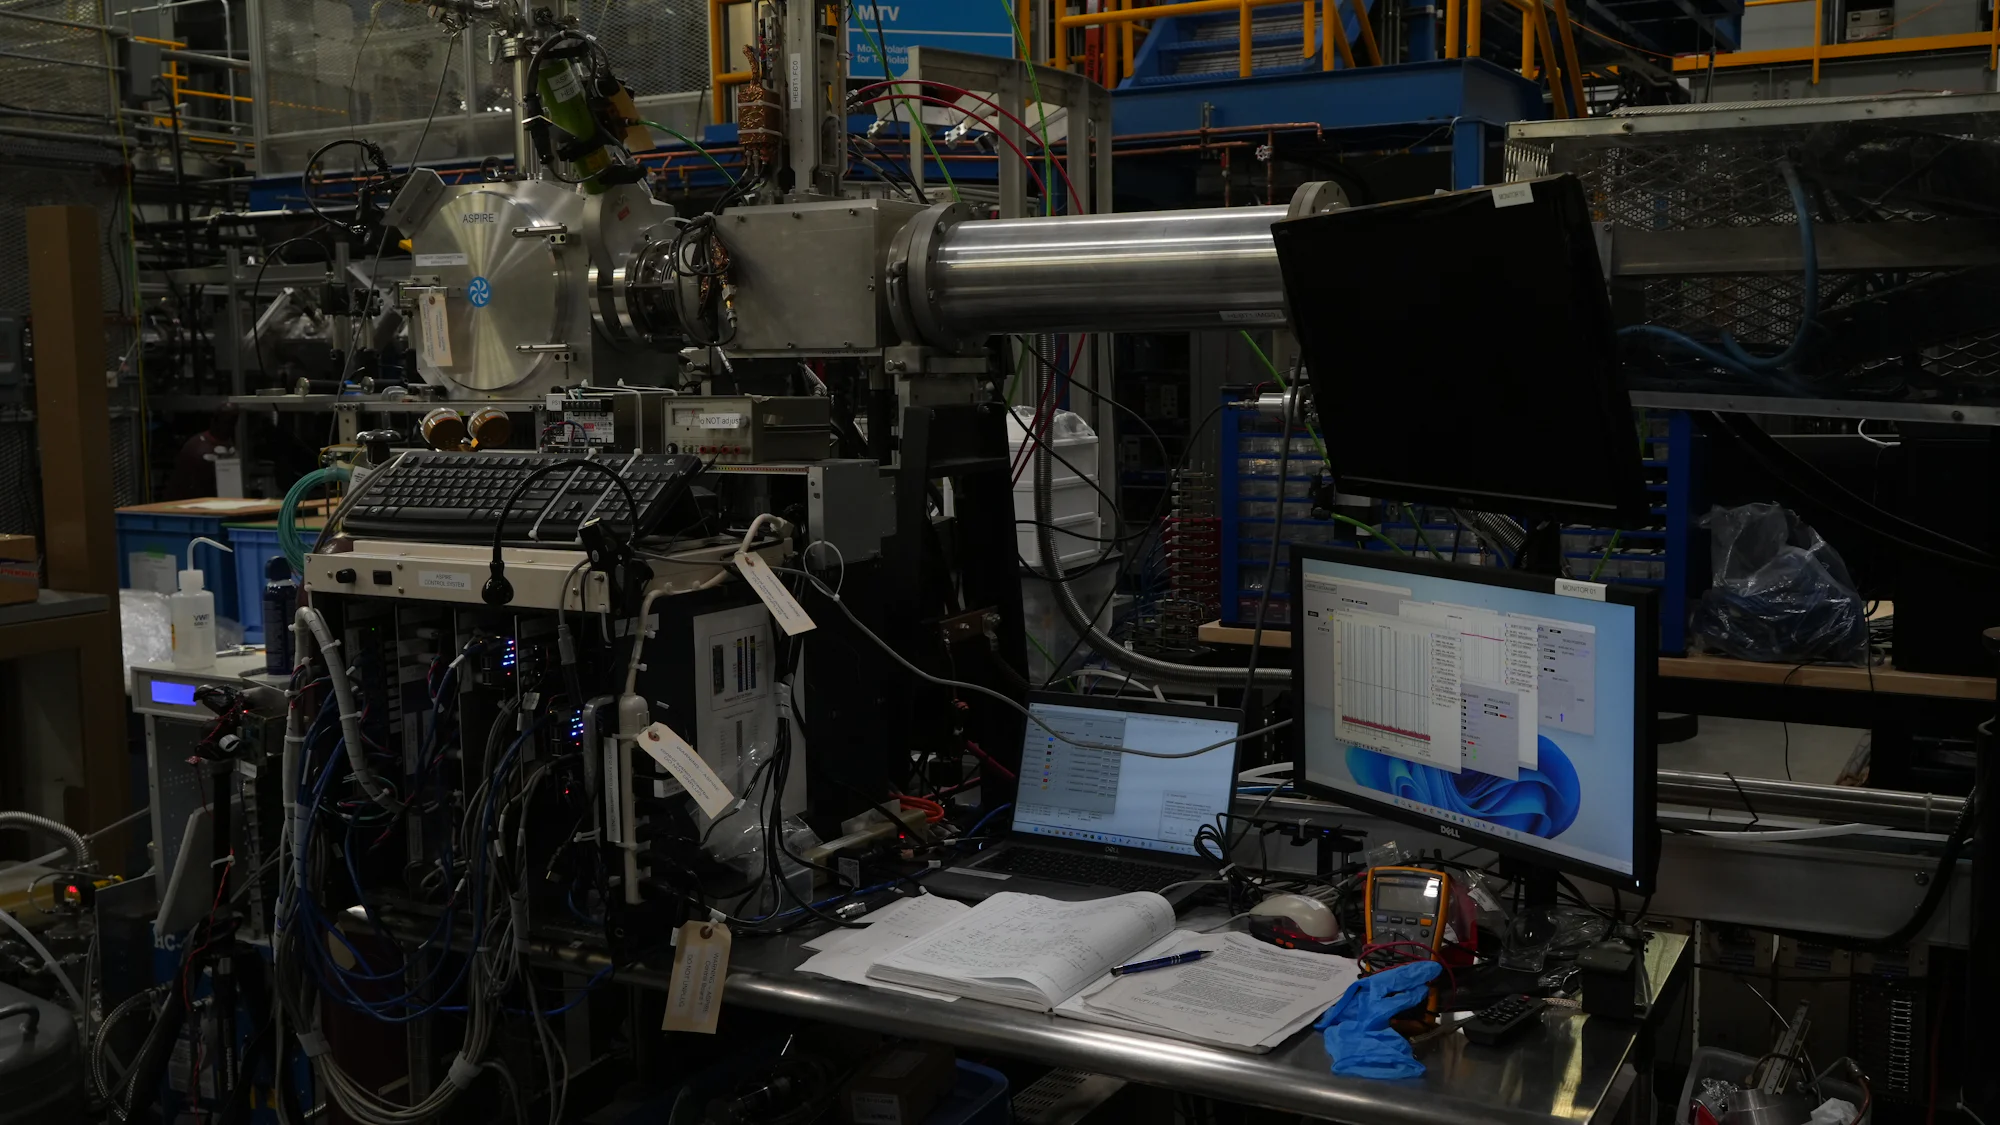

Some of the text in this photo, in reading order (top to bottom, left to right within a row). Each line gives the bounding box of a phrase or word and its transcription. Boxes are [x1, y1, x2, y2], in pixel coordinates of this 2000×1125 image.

[858, 4, 900, 22] MTV
[857, 55, 870, 63] for
[462, 214, 494, 223] ASPIRE
[1562, 584, 1589, 594] MONITOR
[675, 762, 691, 779] system
[676, 746, 700, 770] WARNING
[702, 773, 720, 791] ASPIRE
[682, 774, 702, 796] UNPLUG
[1440, 824, 1461, 838] DELL
[1104, 846, 1119, 854] DELL
[687, 954, 694, 964] DO
[702, 960, 711, 981] Control
[708, 952, 720, 984] WARNING
[678, 980, 690, 1008] UNPLUG
[703, 992, 712, 1013] ASPIRE
